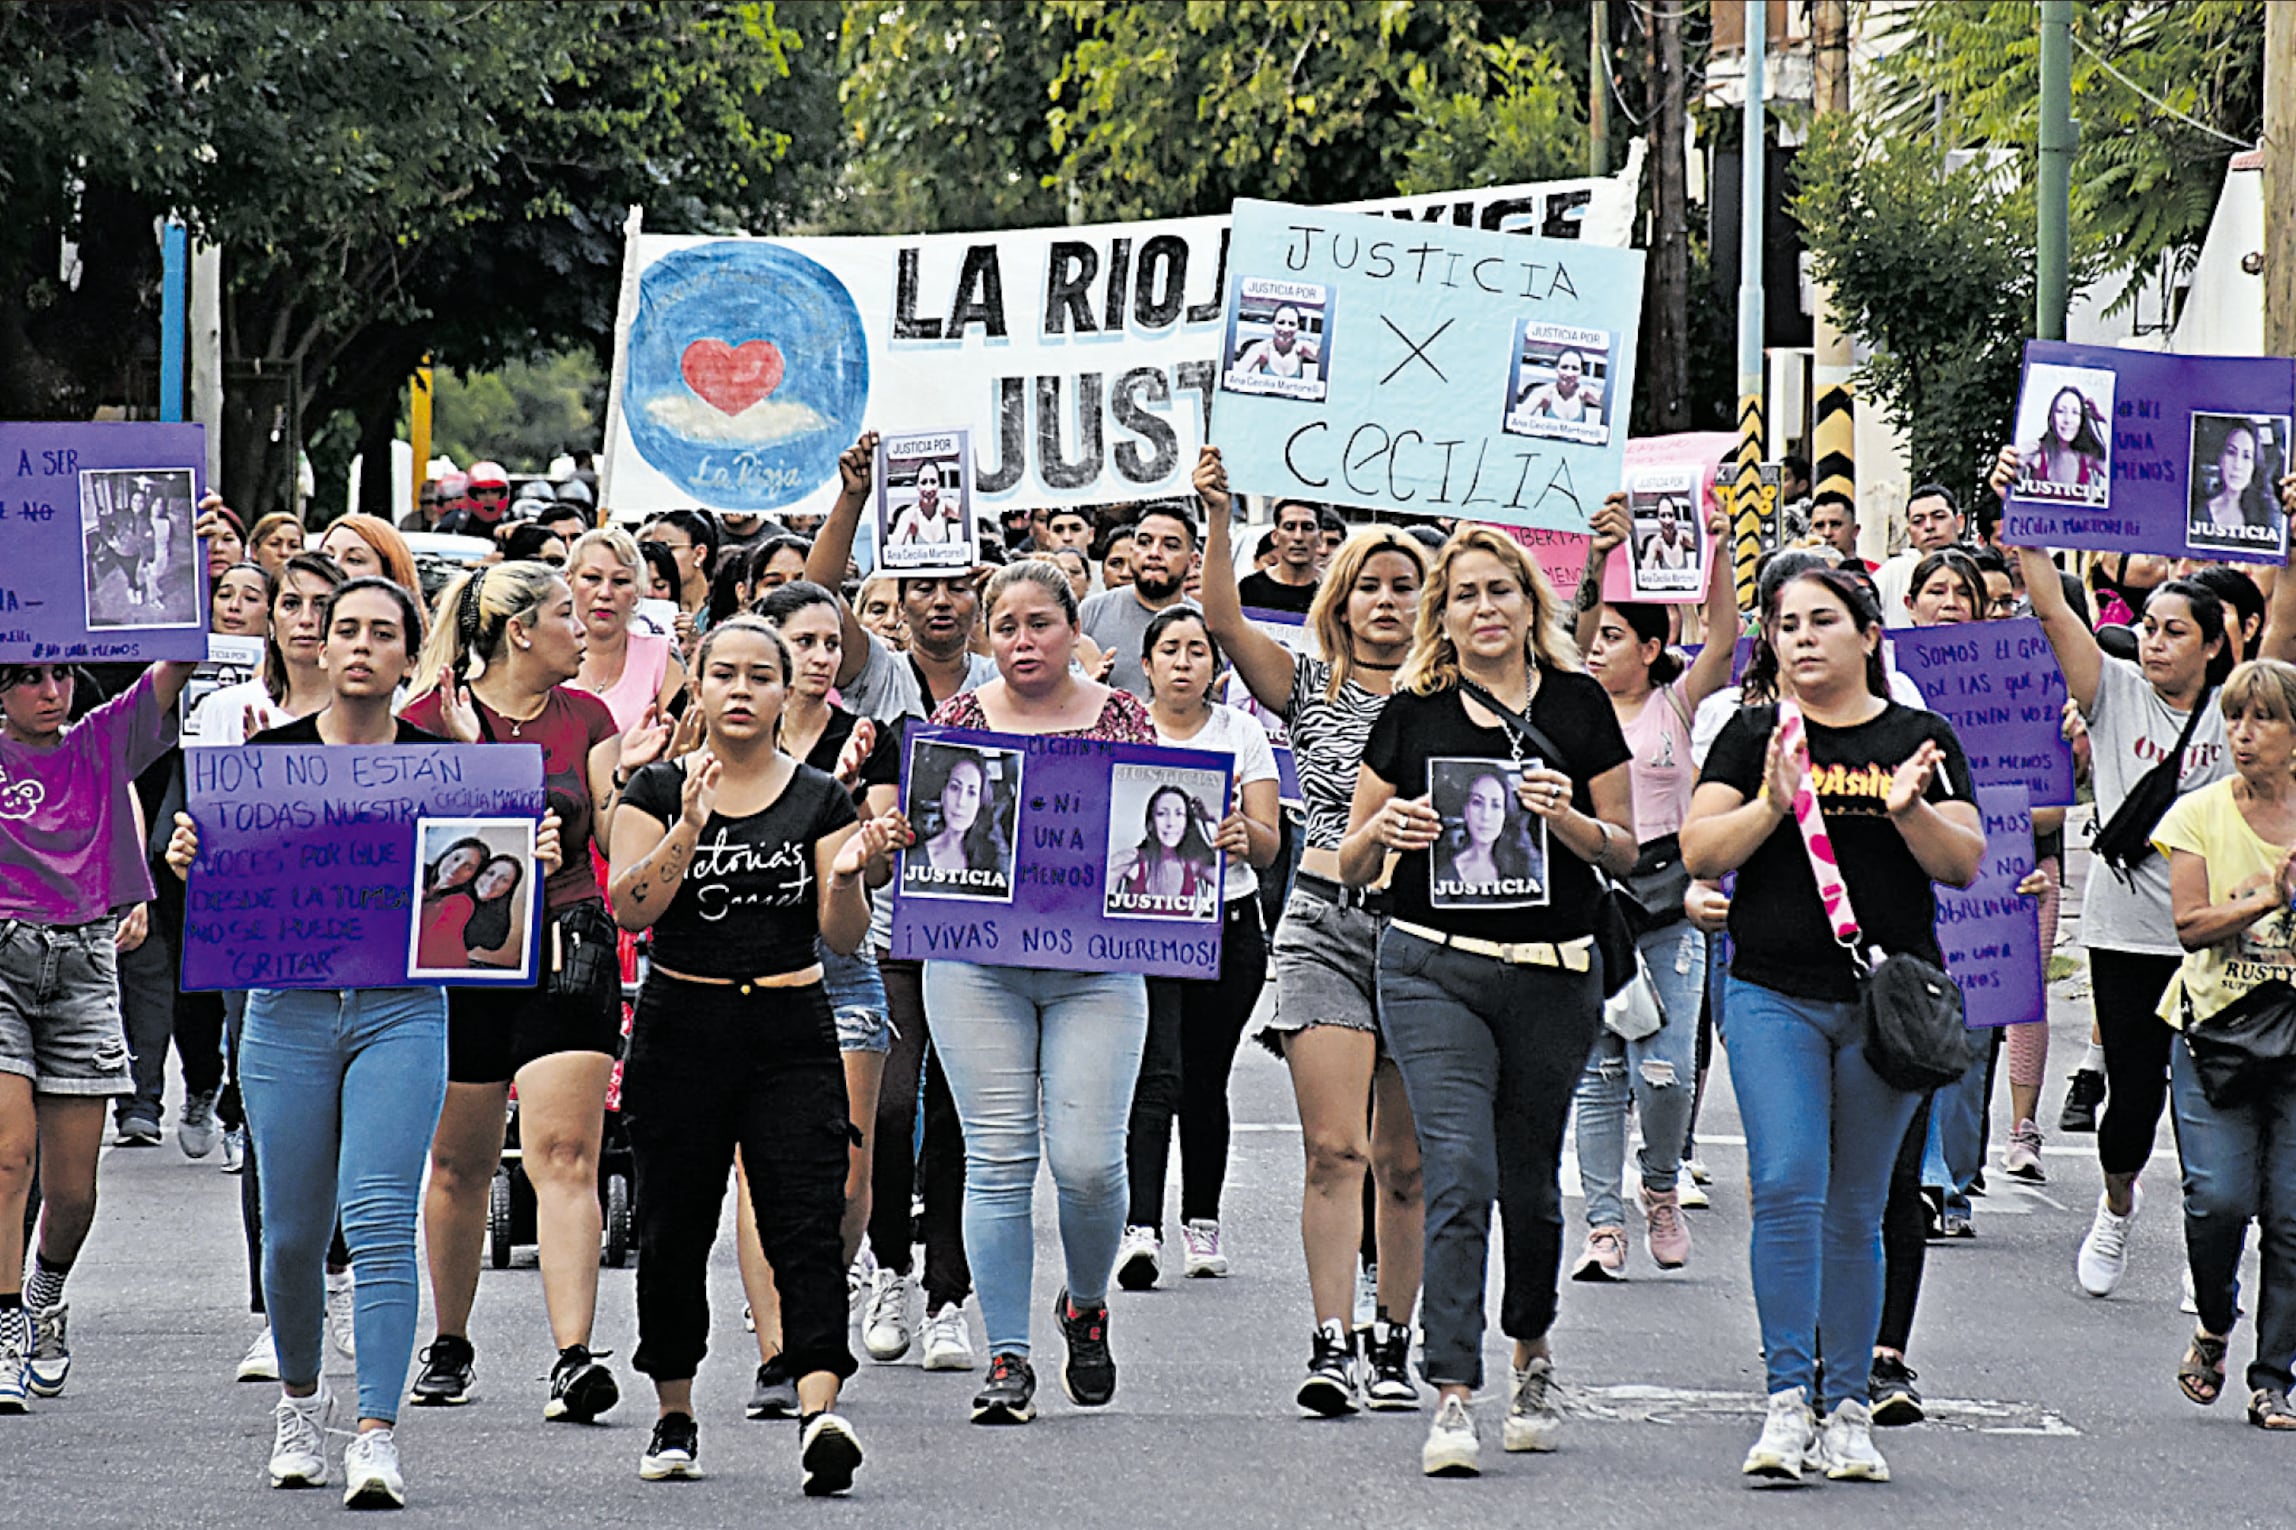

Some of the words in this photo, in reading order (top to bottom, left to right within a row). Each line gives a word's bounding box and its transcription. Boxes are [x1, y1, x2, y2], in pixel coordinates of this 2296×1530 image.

[1286, 226, 1578, 300] JUSTICIA
[893, 244, 1007, 339] LA
[1045, 228, 1231, 334] RIOJ
[1249, 282, 1294, 297] JUSTICIA
[1296, 287, 1317, 299] POR
[1532, 327, 1577, 341] JUSTICIA
[1581, 331, 1600, 343] POR
[1379, 315, 1455, 384] X
[1247, 377, 1275, 388] Cecilia
[976, 360, 1216, 493] JUST
[1529, 419, 1557, 430] Cecilia
[893, 440, 932, 454] JUSTICIA
[934, 439, 951, 451] POR
[17, 450, 32, 477] A
[44, 449, 78, 477] SER
[689, 456, 730, 487] La
[2190, 521, 2280, 542] JUSTICIA
[888, 550, 901, 559] Ana
[902, 549, 928, 560] Cecilia
[1917, 640, 1979, 668] SOMOS
[2021, 705, 2054, 723] VOZ
[196, 750, 263, 793] HOY
[286, 753, 329, 786] NO
[353, 749, 463, 788] ESTÁN
[2000, 754, 2052, 769] MENOS
[1117, 766, 1220, 787] JUSTICIA
[210, 800, 316, 832] TODAS
[325, 799, 430, 825] NUESTRA
[1034, 826, 1085, 851] UNA
[905, 863, 1008, 889] JUSTICIA
[1021, 864, 1095, 887] MENOS
[1997, 857, 2025, 875] NO
[192, 887, 277, 912] DESDE
[292, 886, 323, 909] LA
[1434, 878, 1543, 897] JUSTICIA
[280, 917, 364, 941] PUEDE
[1023, 928, 1073, 955] NOS
[1088, 935, 1217, 971] QUEREMOS!
